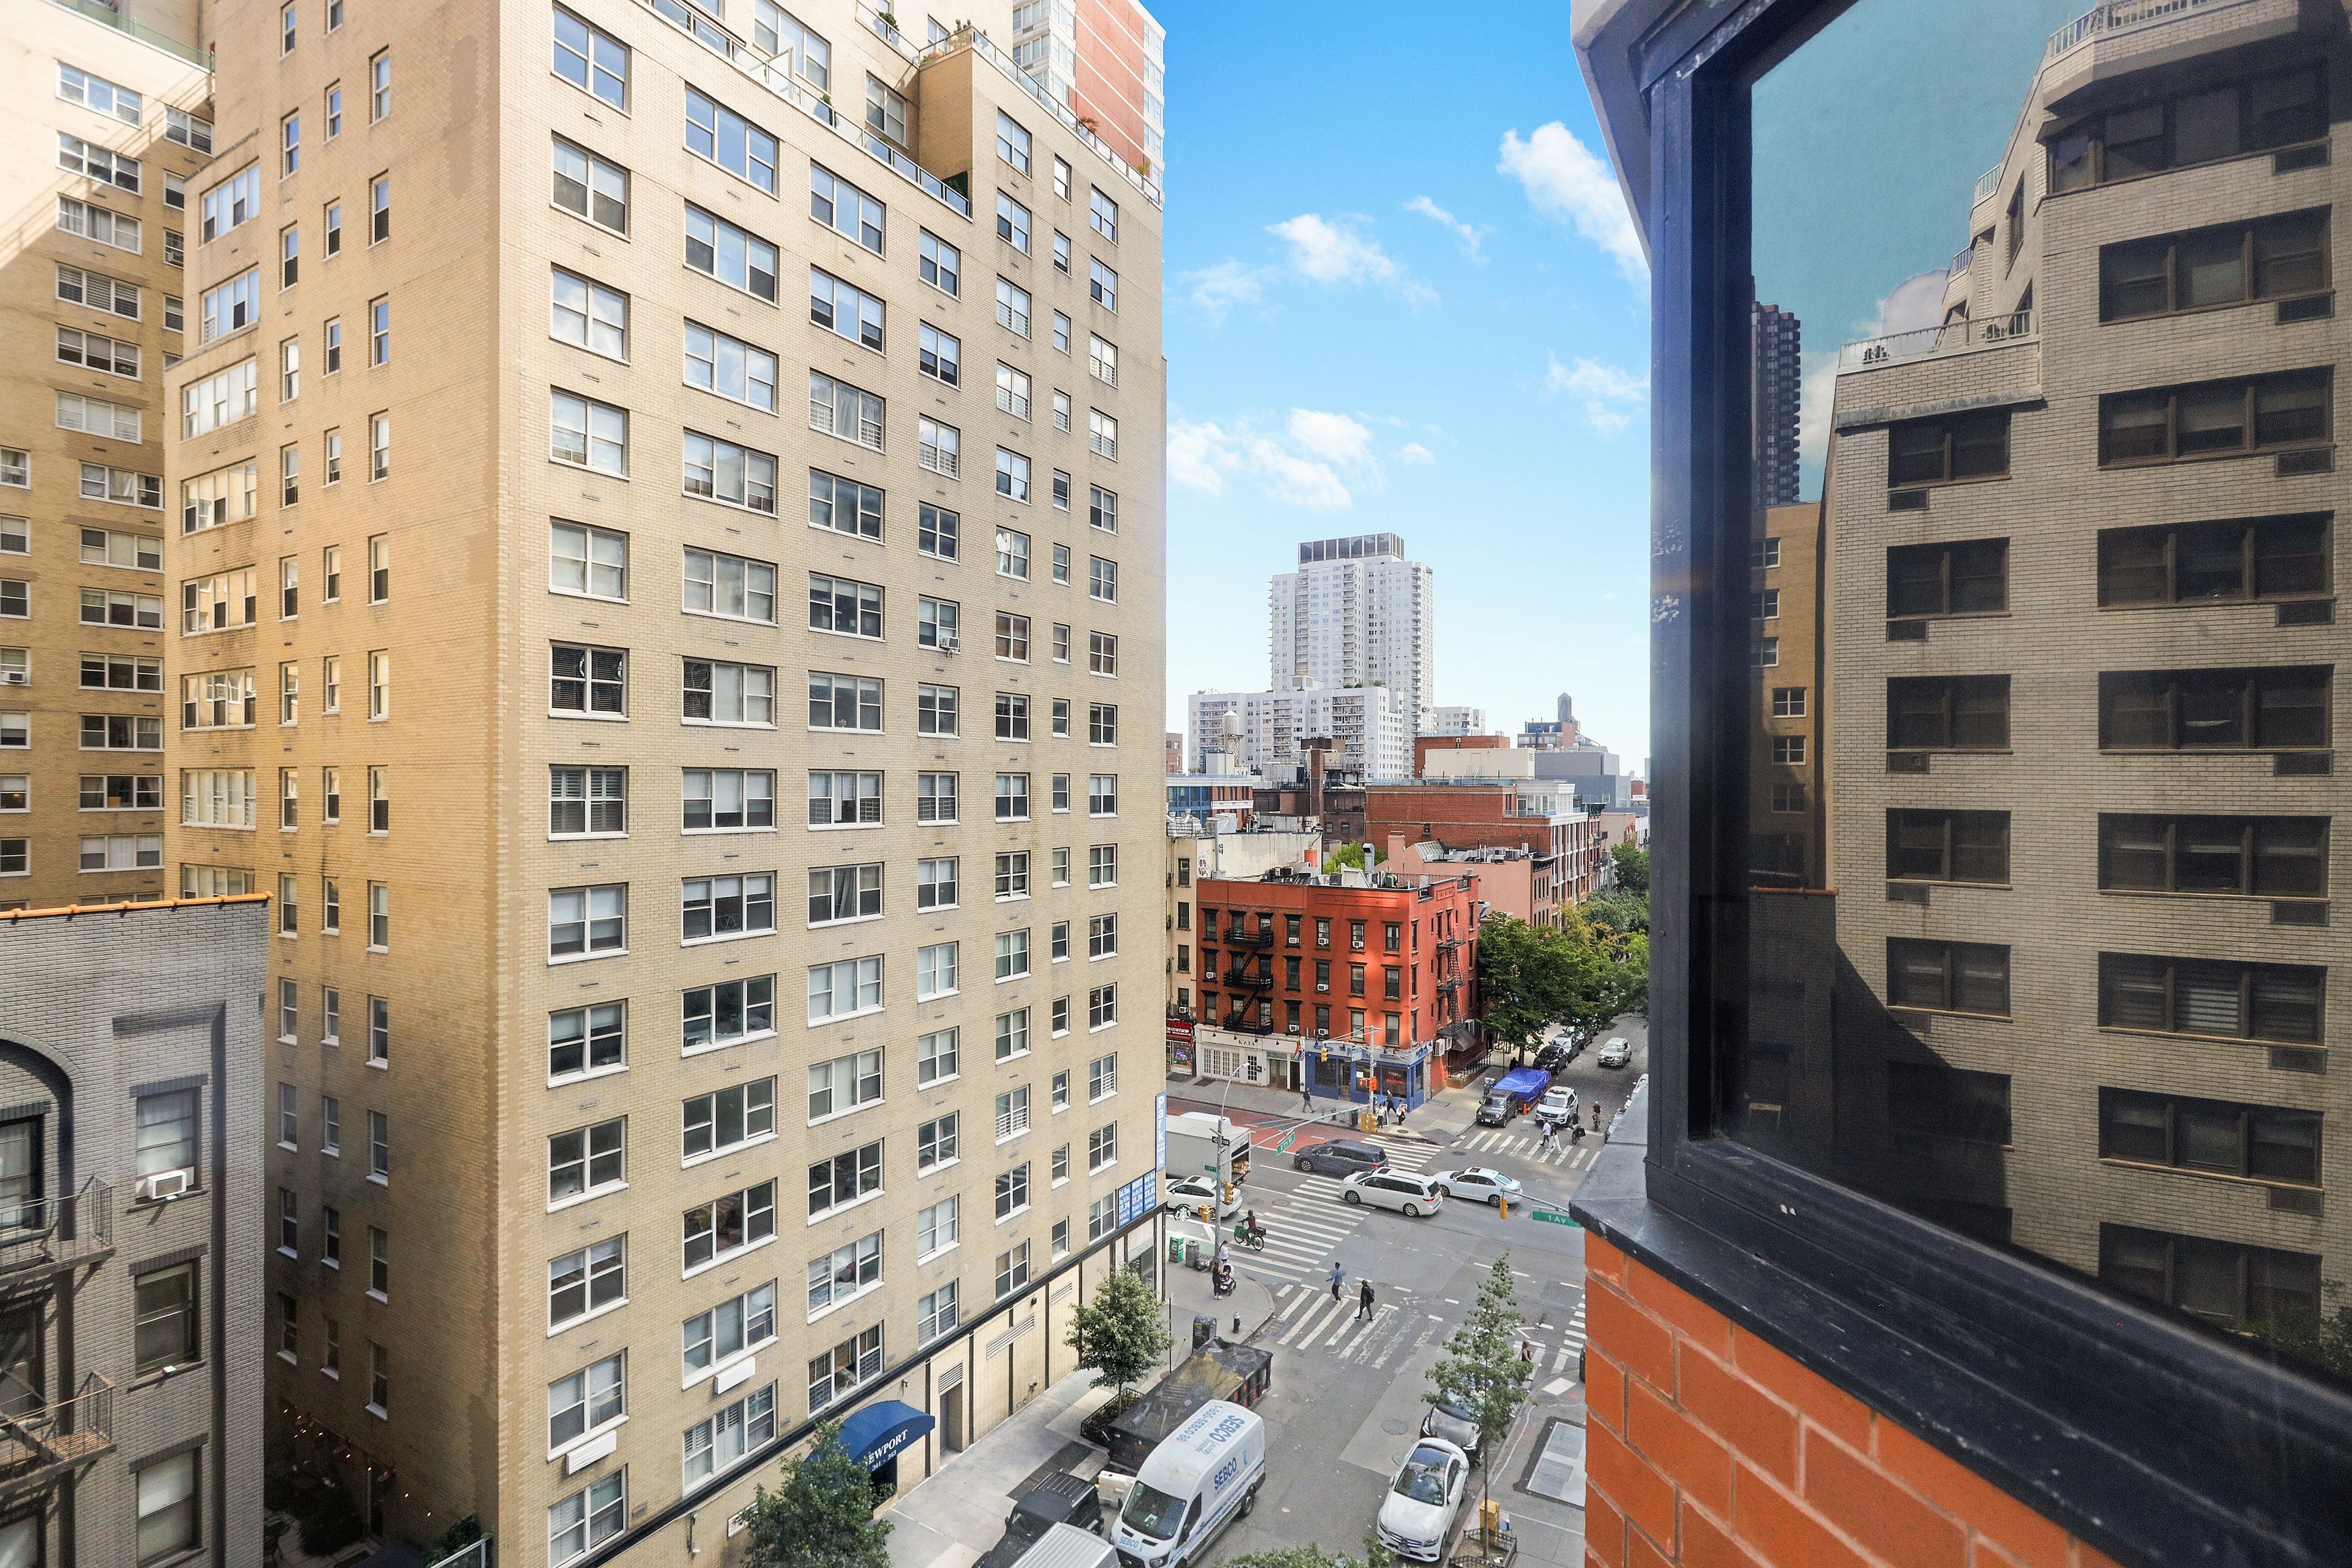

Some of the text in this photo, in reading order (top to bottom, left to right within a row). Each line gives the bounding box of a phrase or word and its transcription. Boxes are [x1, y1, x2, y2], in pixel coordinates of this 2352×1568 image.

[1166, 1019, 1192, 1030] moke
[1209, 1414, 1245, 1443] SEBCO
[1214, 1457, 1237, 1490] SEBCO
[1119, 1536, 1139, 1548] SEBCO
